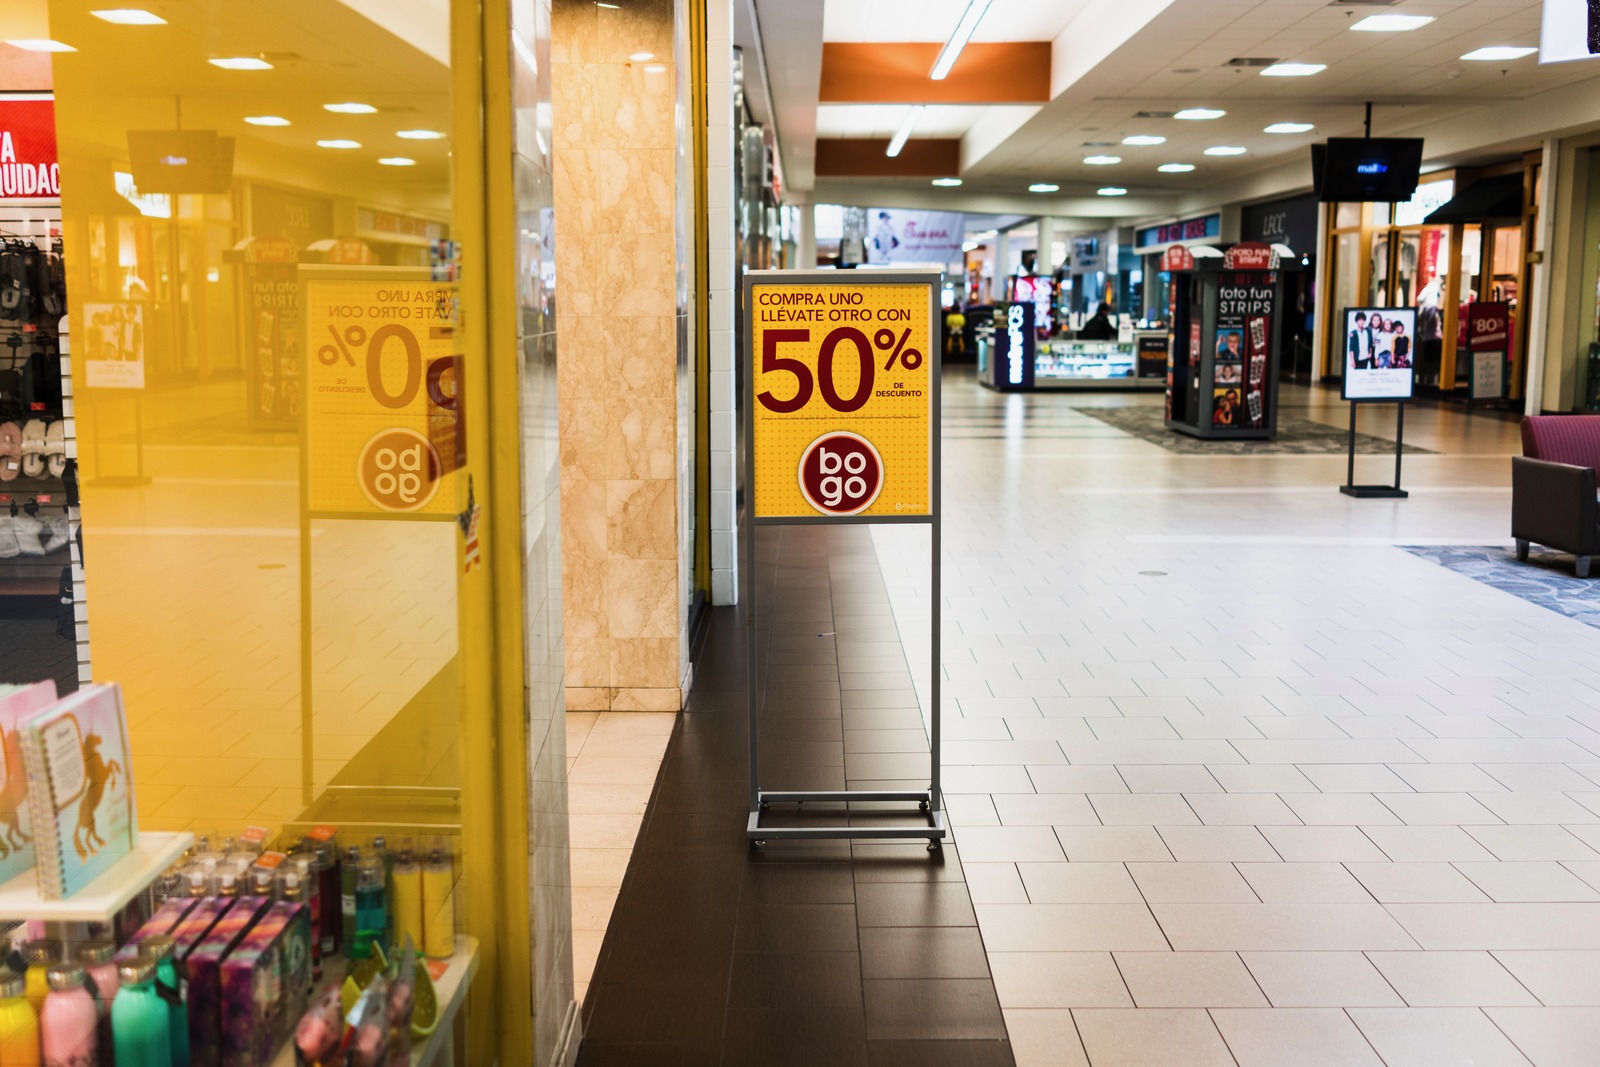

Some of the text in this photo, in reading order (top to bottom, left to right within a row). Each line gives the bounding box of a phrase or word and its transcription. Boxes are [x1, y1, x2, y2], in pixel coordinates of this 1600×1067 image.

[0, 131, 17, 163] A
[759, 293, 864, 305] COMPRA UNO
[1220, 286, 1272, 299] foto fun
[761, 307, 911, 322] LLÉVATE OTRO CON
[1220, 300, 1271, 314] STRIPS
[756, 326, 923, 413] 50%
[819, 447, 867, 475] bo
[819, 476, 867, 507] go
